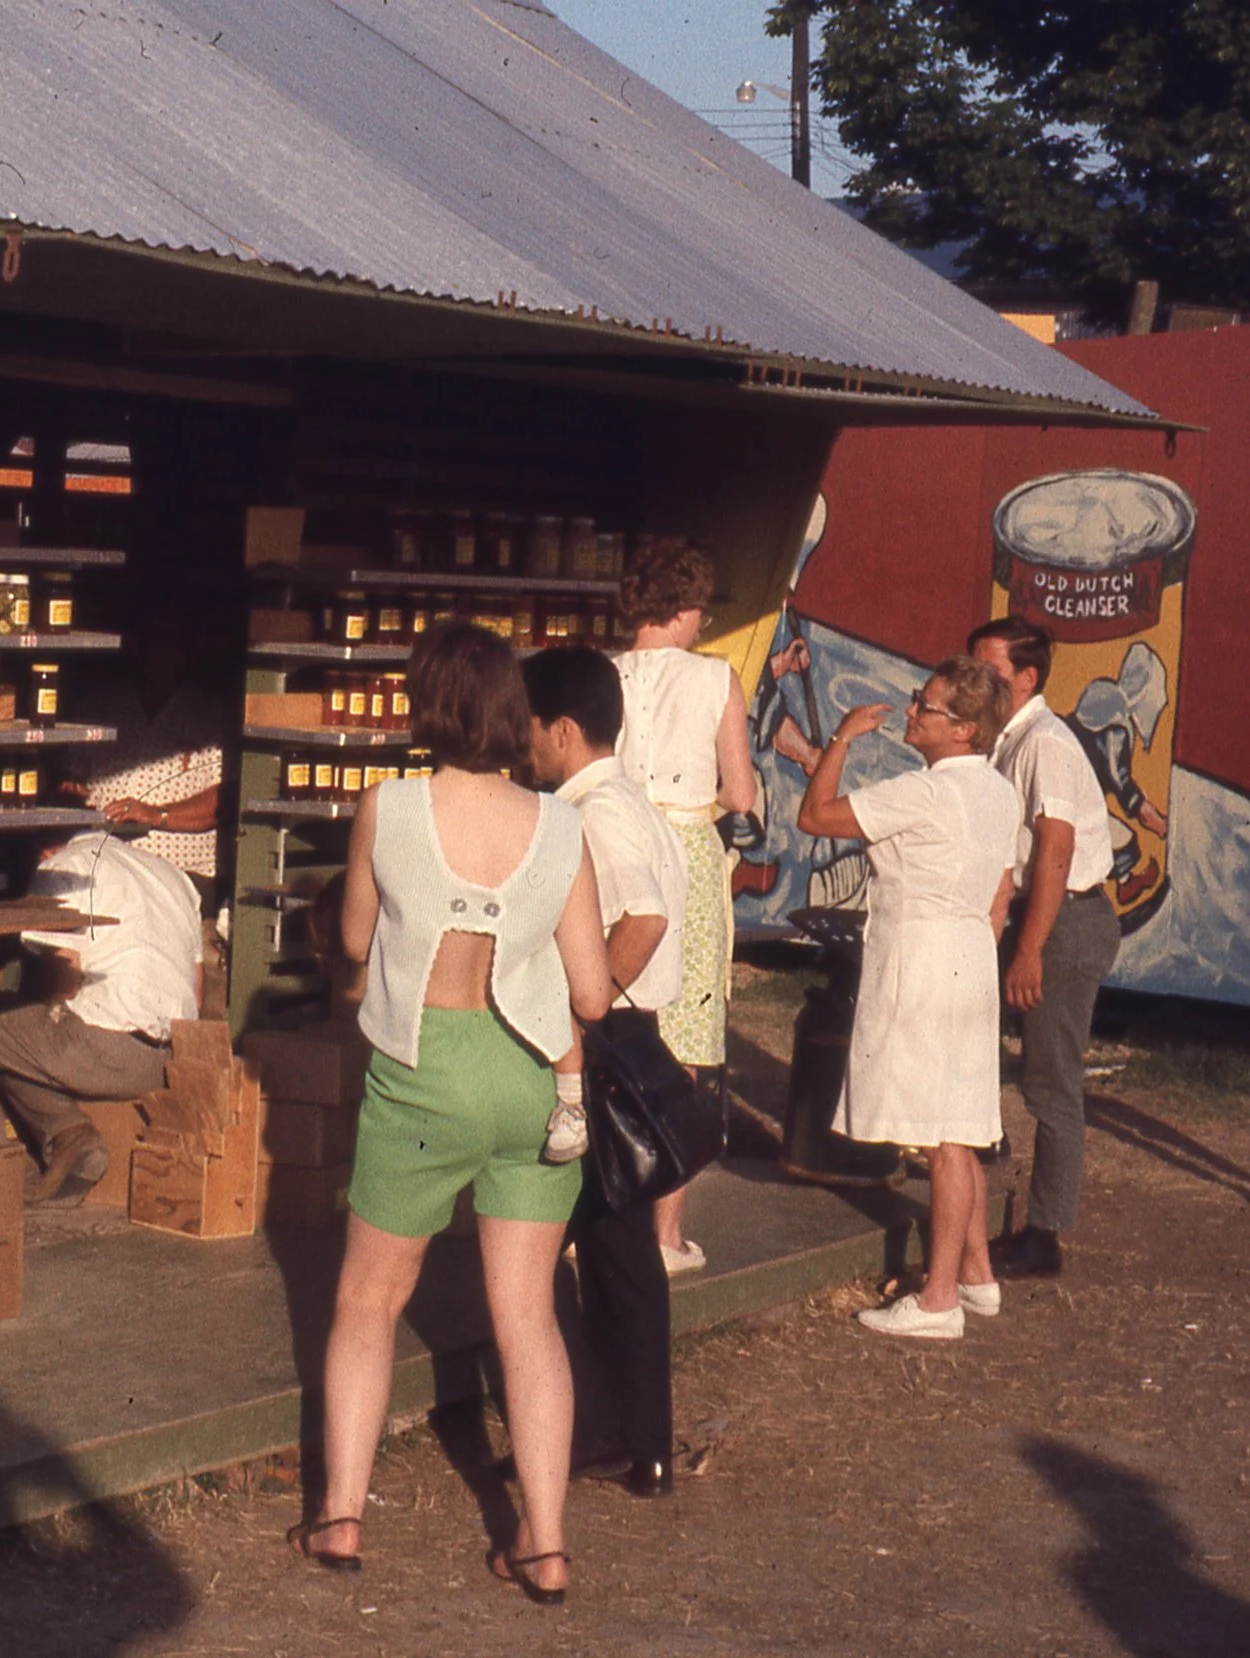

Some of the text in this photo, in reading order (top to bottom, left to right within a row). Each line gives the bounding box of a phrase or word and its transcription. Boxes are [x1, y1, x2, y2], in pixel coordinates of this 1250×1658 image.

[1034, 572, 1134, 593] OLD DUTCH
[1045, 595, 1129, 618] CLEANSER
